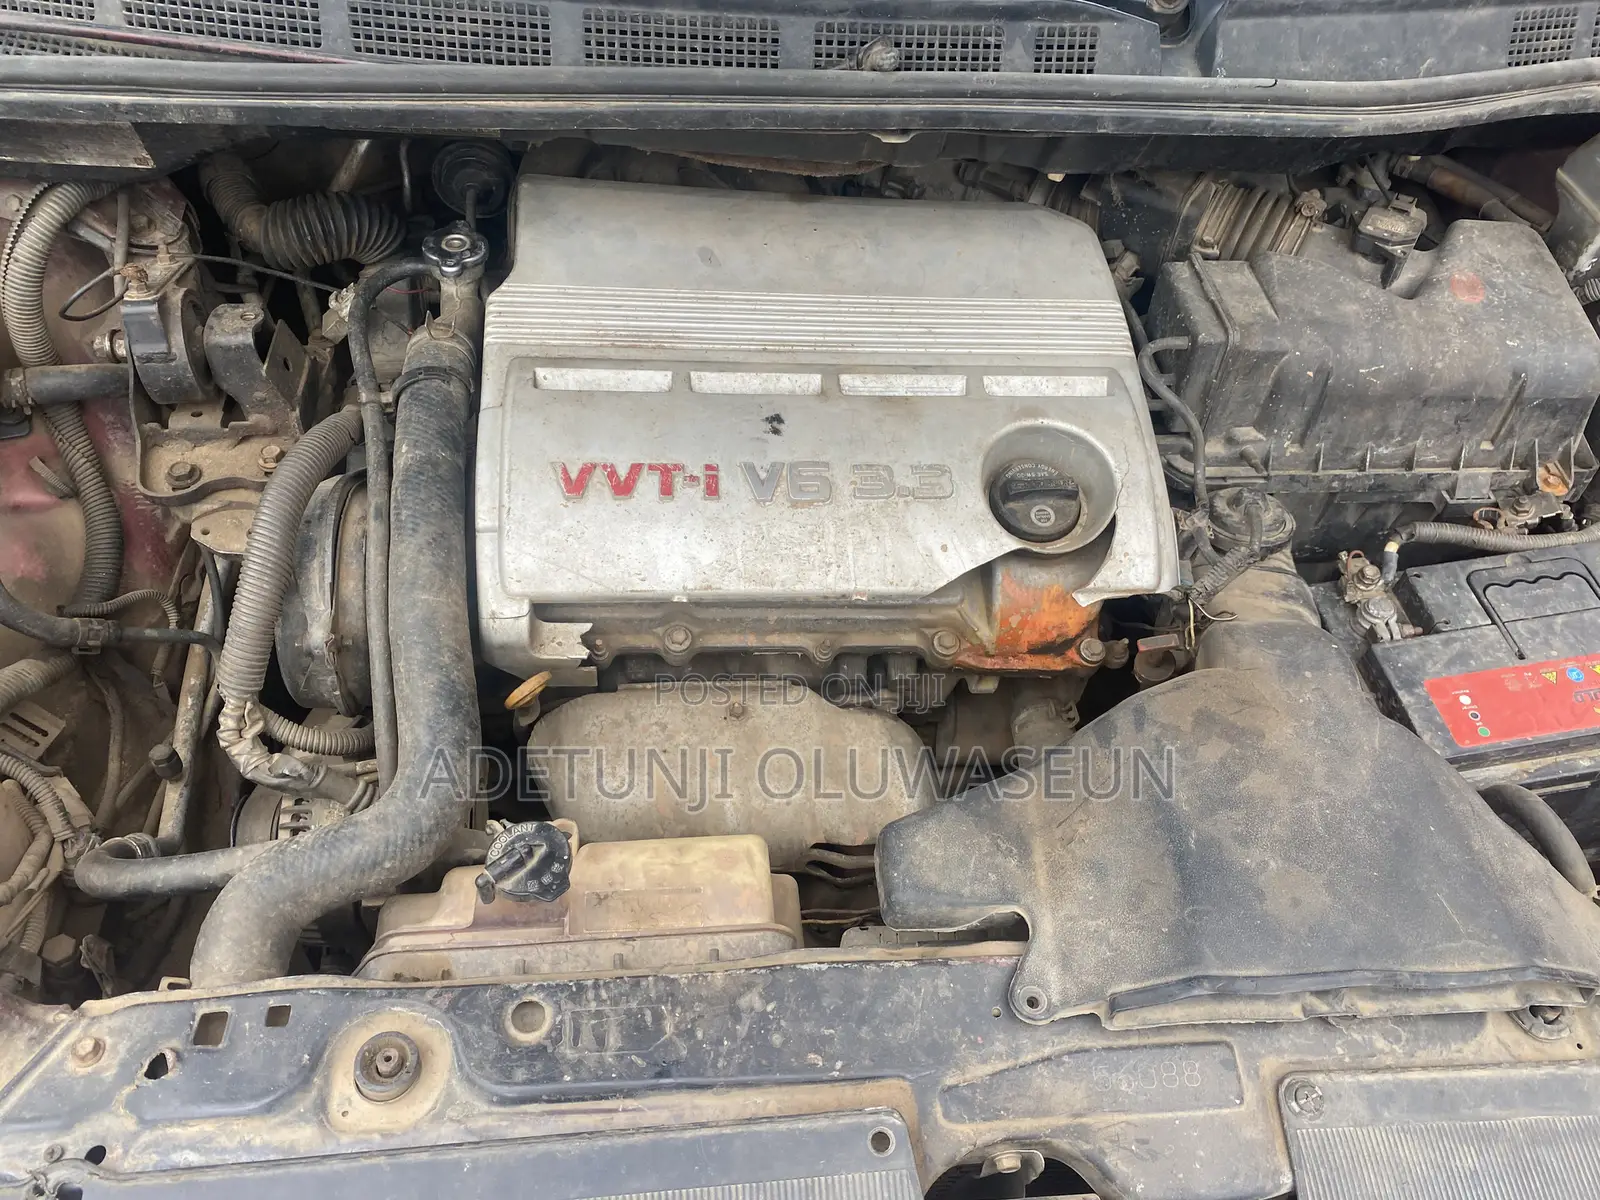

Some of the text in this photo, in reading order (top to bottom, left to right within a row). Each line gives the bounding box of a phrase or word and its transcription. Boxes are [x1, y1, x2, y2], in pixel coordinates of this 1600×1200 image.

[549, 460, 956, 505] VVT-i V6 3.3
[1005, 463, 1059, 479] ENERGY CONSERVING
[489, 822, 537, 858] COOLANT
